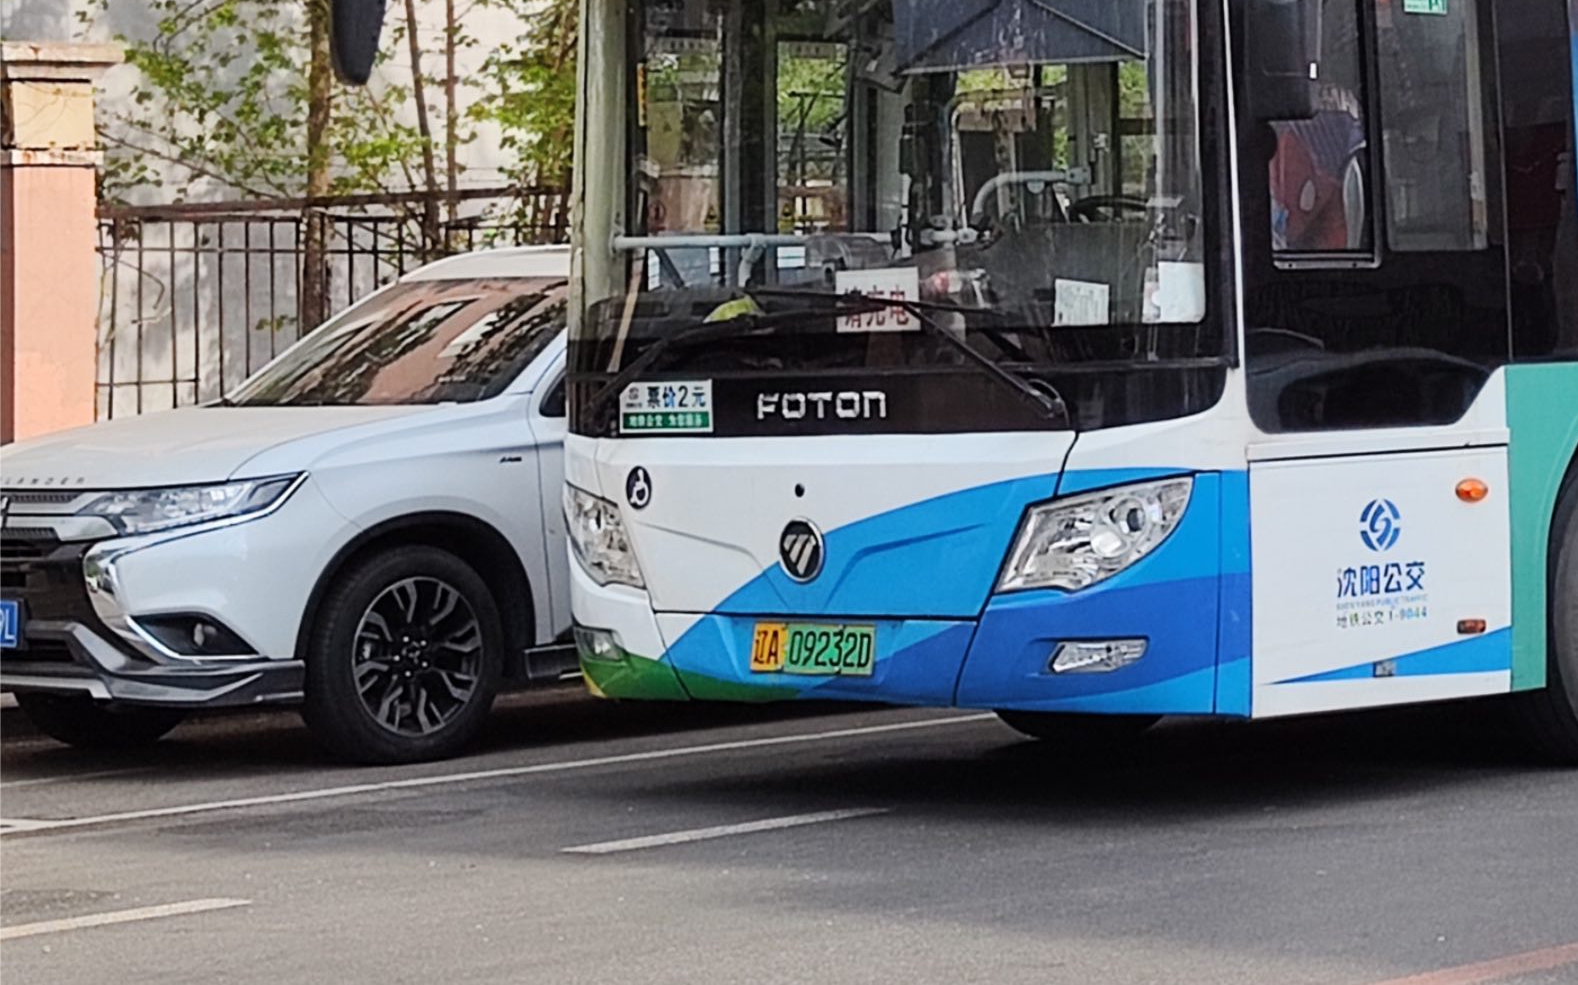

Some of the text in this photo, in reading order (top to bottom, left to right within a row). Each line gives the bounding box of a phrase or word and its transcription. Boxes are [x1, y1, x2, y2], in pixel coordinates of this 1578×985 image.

[646, 384, 706, 409] 票价2元
[755, 390, 888, 421] FOTON
[1336, 560, 1426, 599] 沈阳公交
[752, 629, 873, 668] 辽A 09232D
